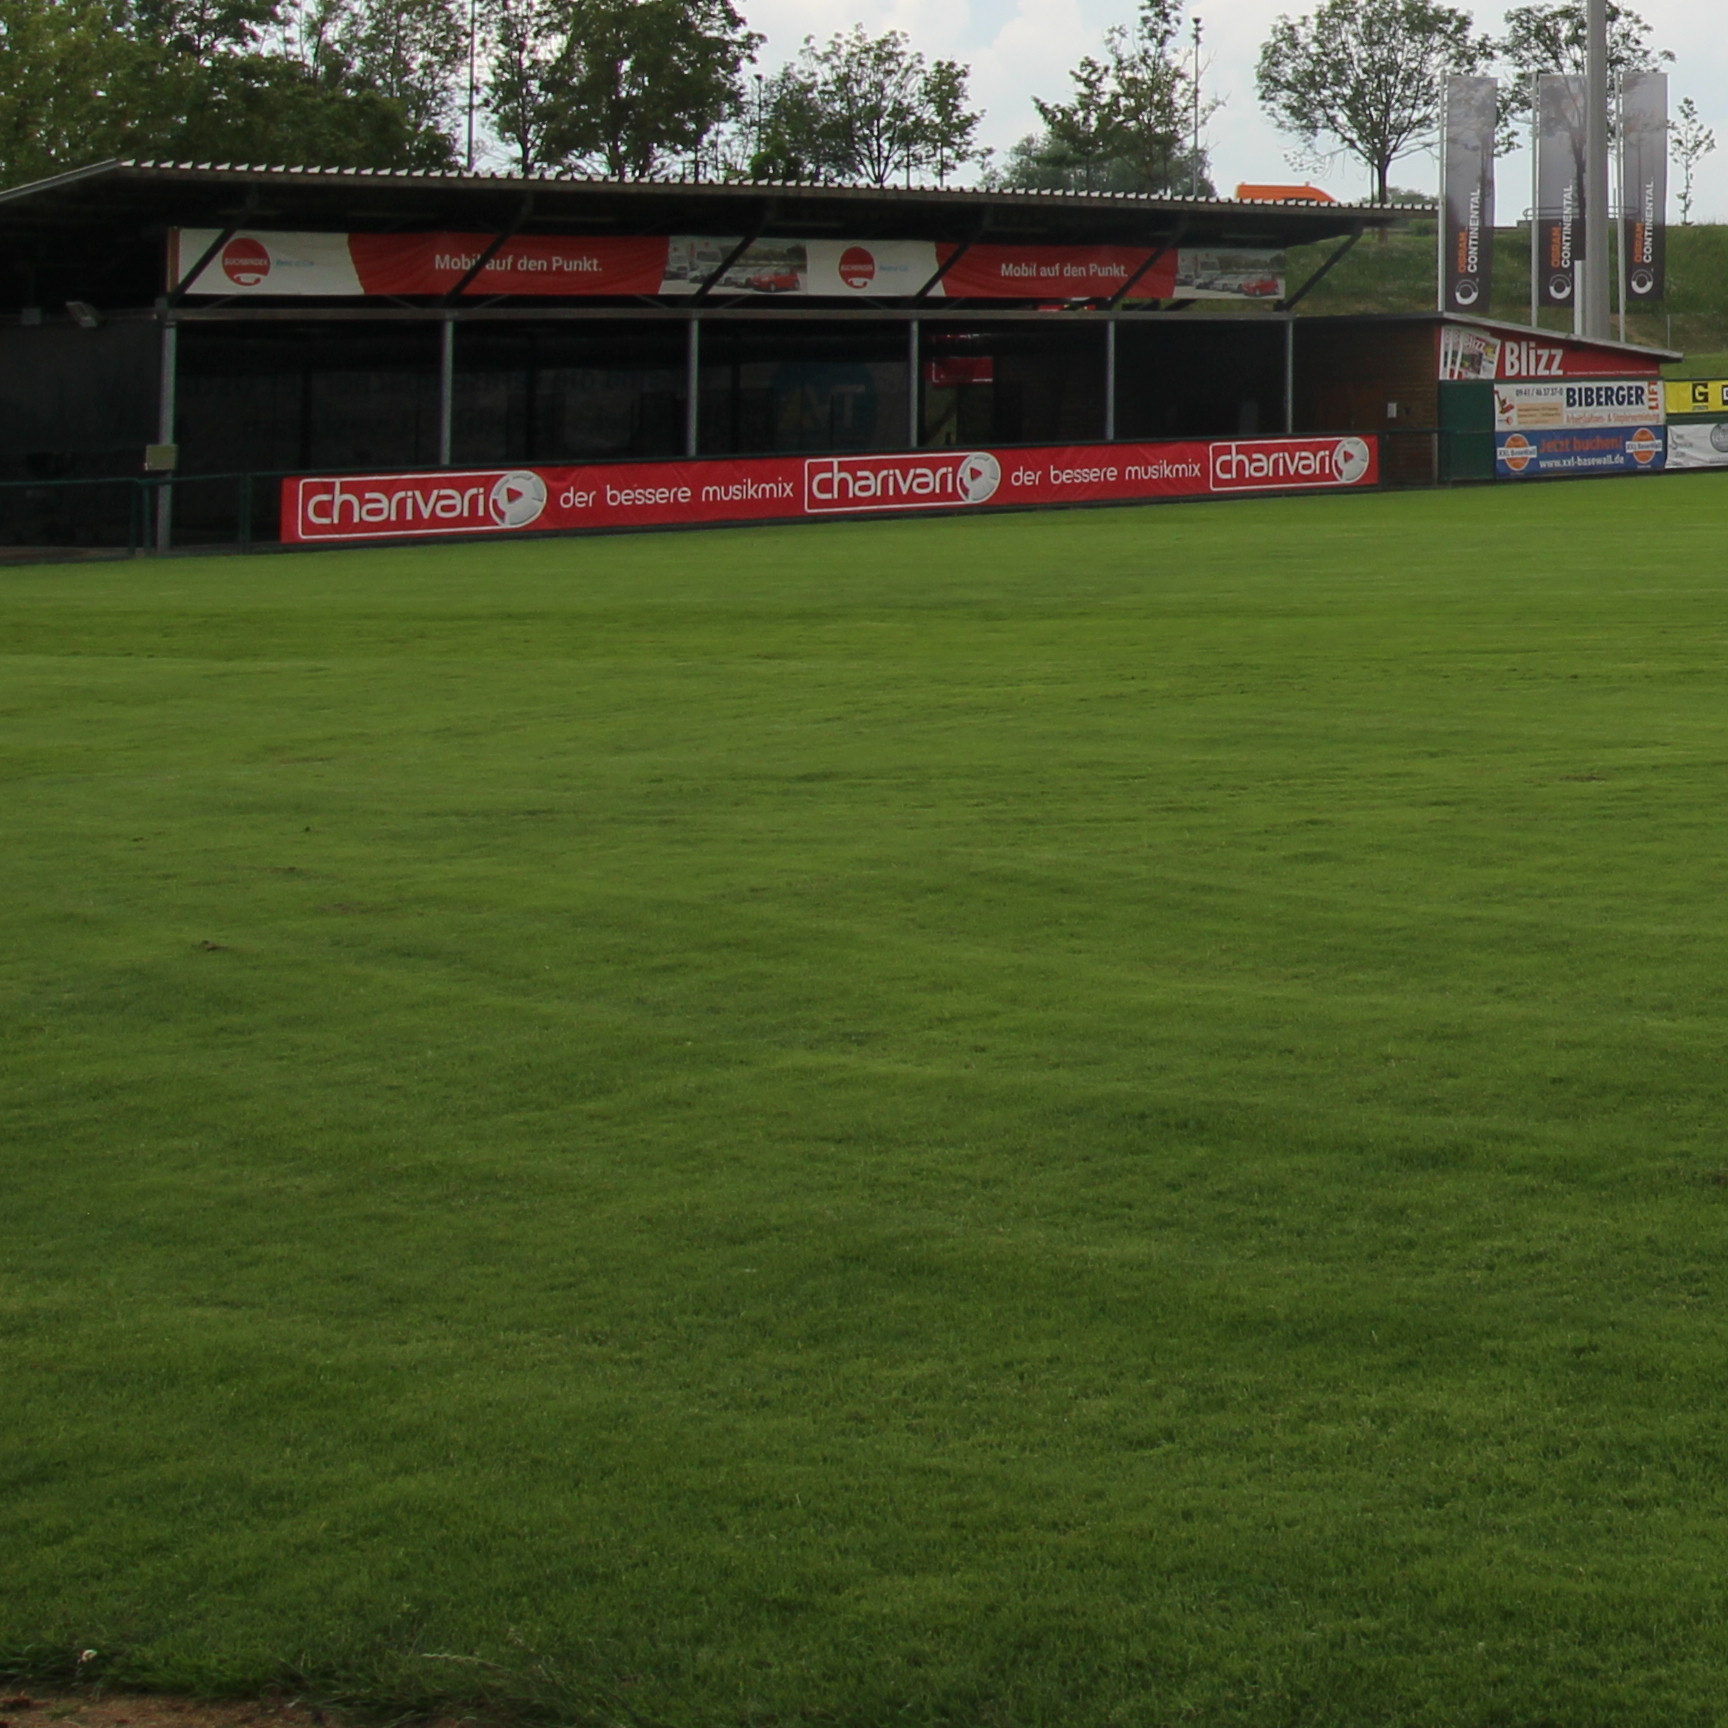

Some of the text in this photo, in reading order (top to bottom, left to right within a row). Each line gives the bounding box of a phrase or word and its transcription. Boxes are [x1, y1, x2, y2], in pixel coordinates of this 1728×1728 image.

[484, 255, 513, 270] auf
[517, 256, 547, 271] den
[551, 257, 603, 272] Punkt.
[1001, 262, 1128, 277] Mobil auf den Punkt.
[1505, 341, 1563, 377] Blizz
[1567, 386, 1645, 408] BIBERGER
[1011, 458, 1201, 486] der bessere musikmix
[1216, 442, 1330, 479] charivari
[560, 477, 794, 508] der bessere musikmix
[812, 458, 953, 499] charivari
[307, 480, 484, 524] charivari
